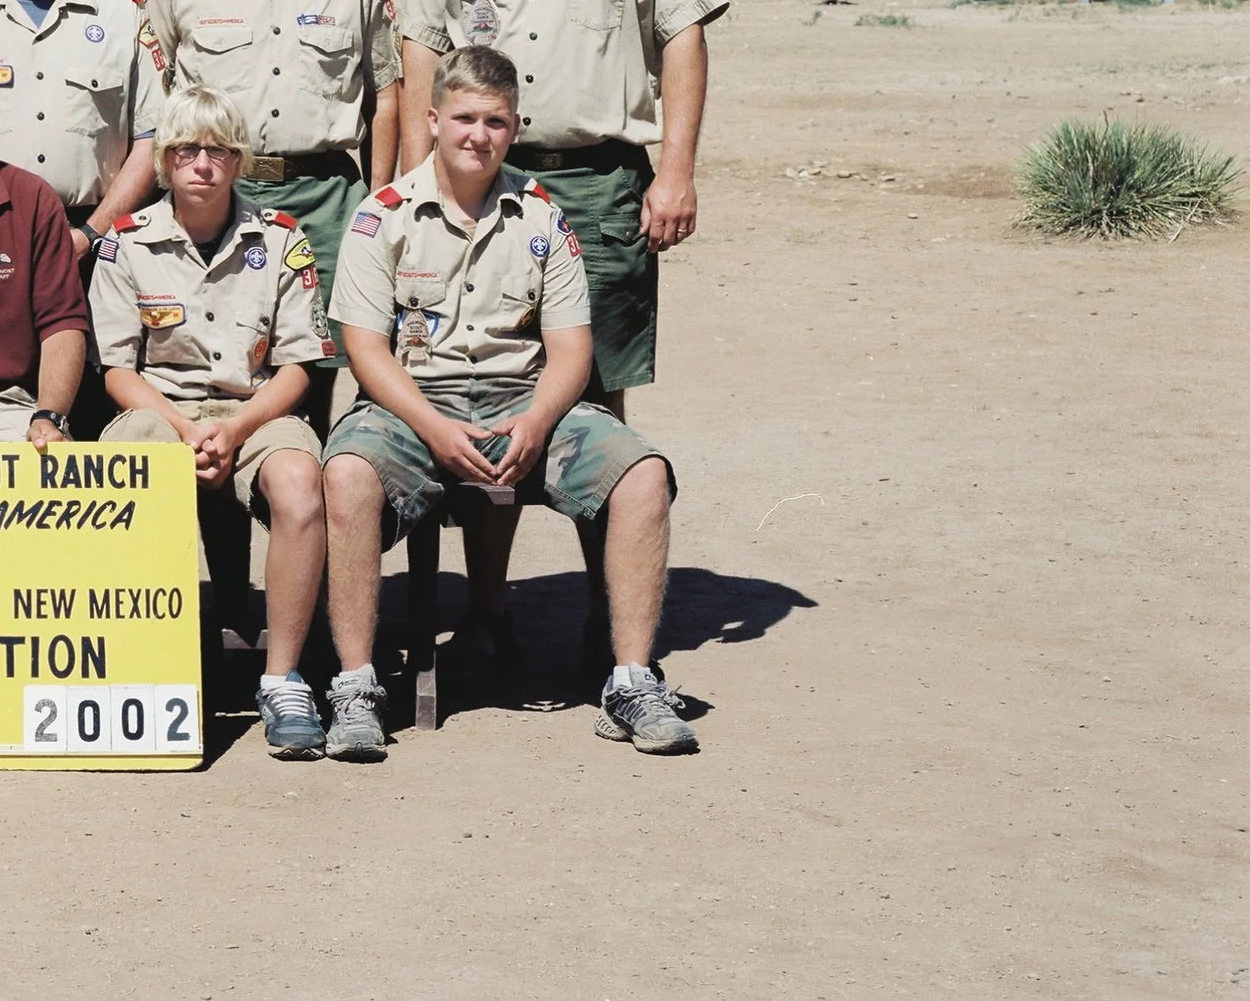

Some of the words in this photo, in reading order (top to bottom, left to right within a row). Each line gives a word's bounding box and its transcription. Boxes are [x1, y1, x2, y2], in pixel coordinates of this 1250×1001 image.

[40, 454, 149, 490] RANCH
[13, 588, 77, 620] NEW
[88, 587, 183, 620] MEXICO
[34, 697, 191, 745] 2002
